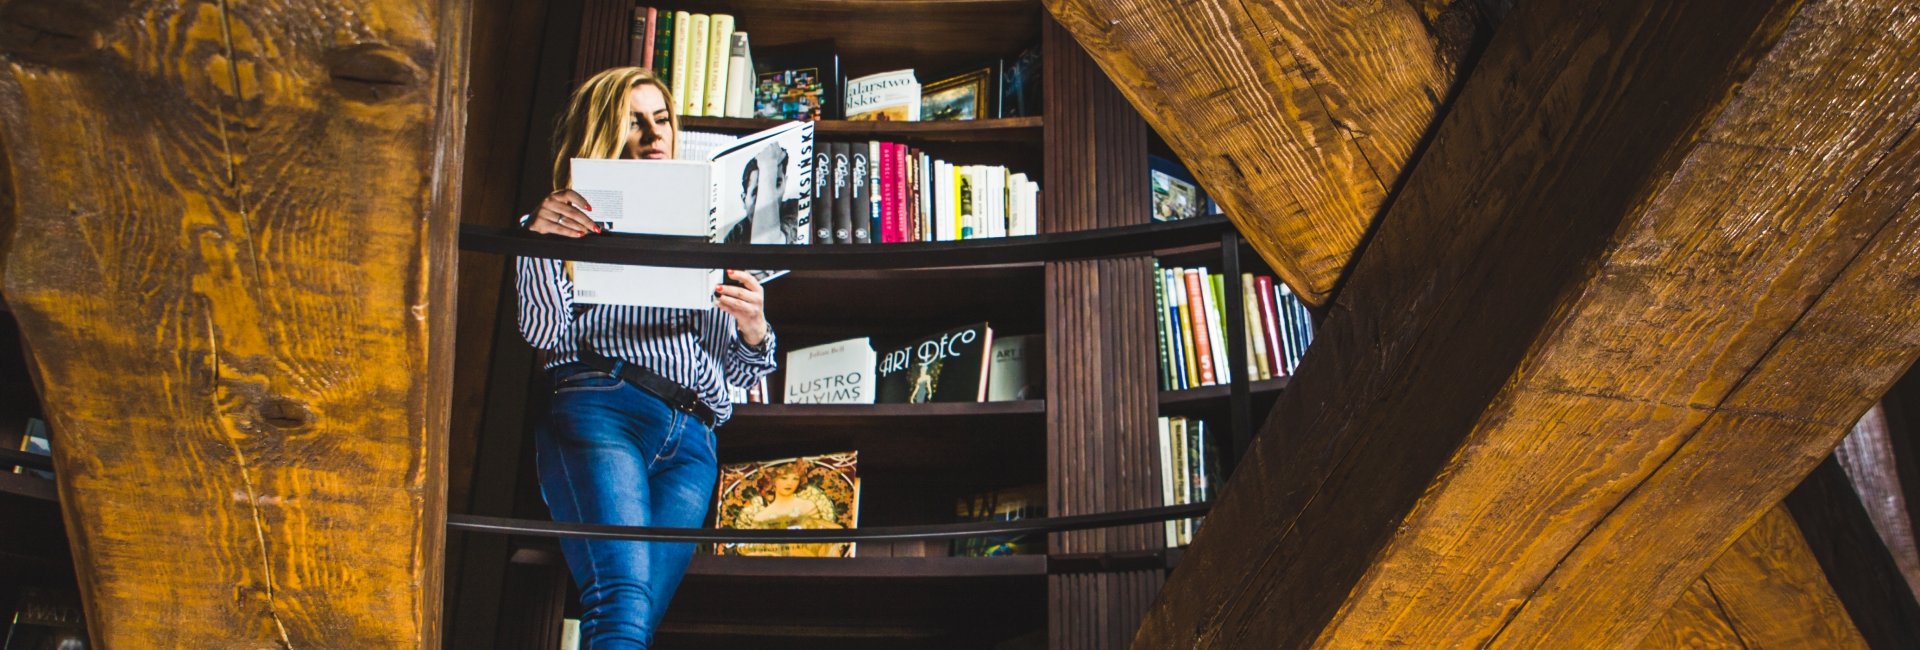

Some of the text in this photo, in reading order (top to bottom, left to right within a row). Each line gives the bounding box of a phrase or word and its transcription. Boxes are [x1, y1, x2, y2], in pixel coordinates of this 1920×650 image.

[846, 78, 910, 97] alarstwo
[846, 92, 881, 109] olskie
[797, 123, 814, 228] BEKSIŃSKI
[879, 345, 913, 377] ART
[996, 349, 1016, 358] ART
[1201, 355, 1211, 371] 5
[790, 372, 862, 396] LUSTRO
